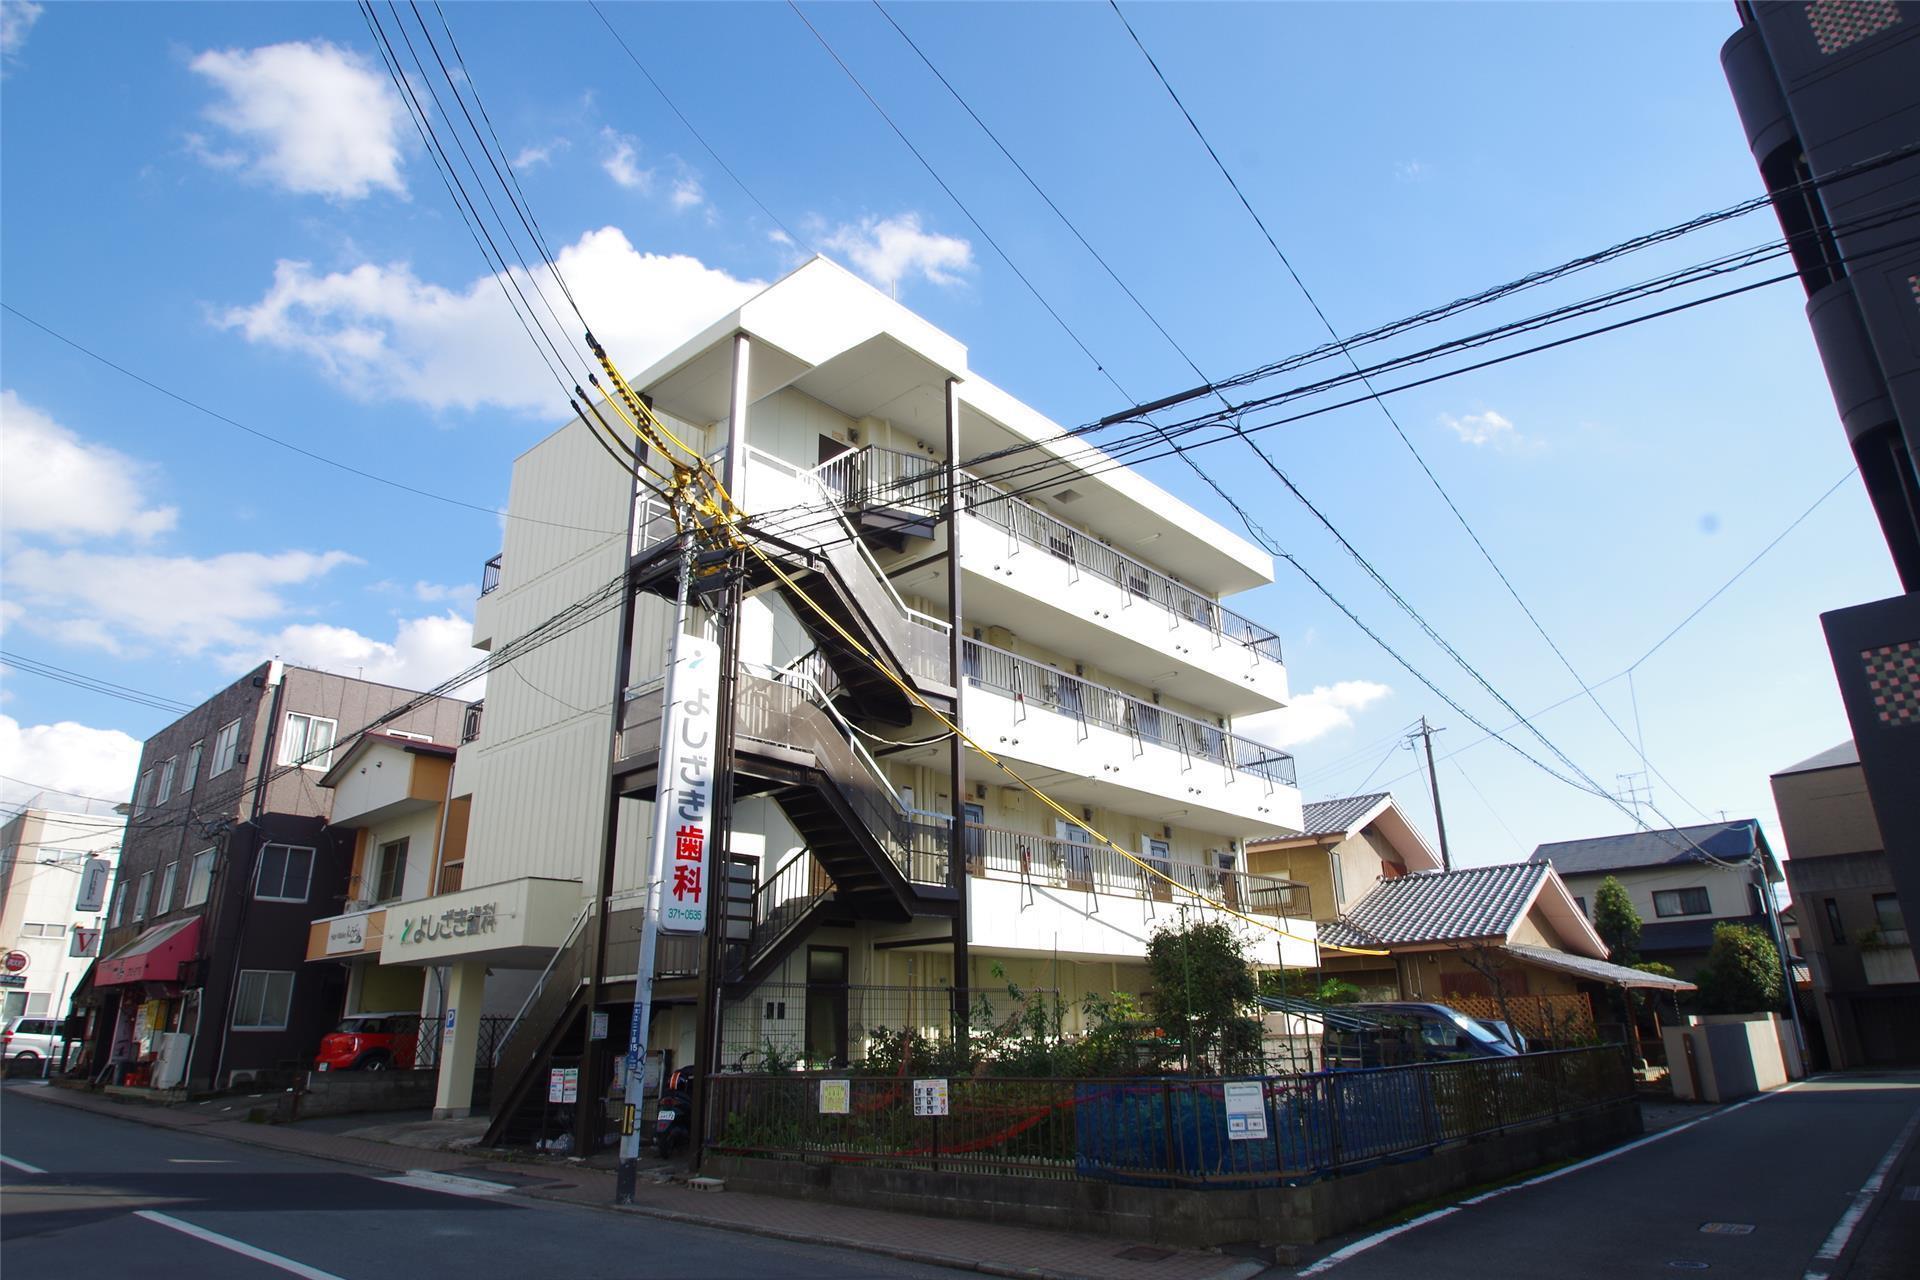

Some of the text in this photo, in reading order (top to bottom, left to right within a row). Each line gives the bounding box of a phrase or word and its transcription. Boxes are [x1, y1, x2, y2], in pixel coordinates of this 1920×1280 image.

[672, 687, 710, 904] よしざき歯科
[413, 902, 497, 944] よしざき歯科
[668, 908, 702, 921] 371-0535
[78, 933, 97, 953] V
[447, 1011, 454, 1027] P
